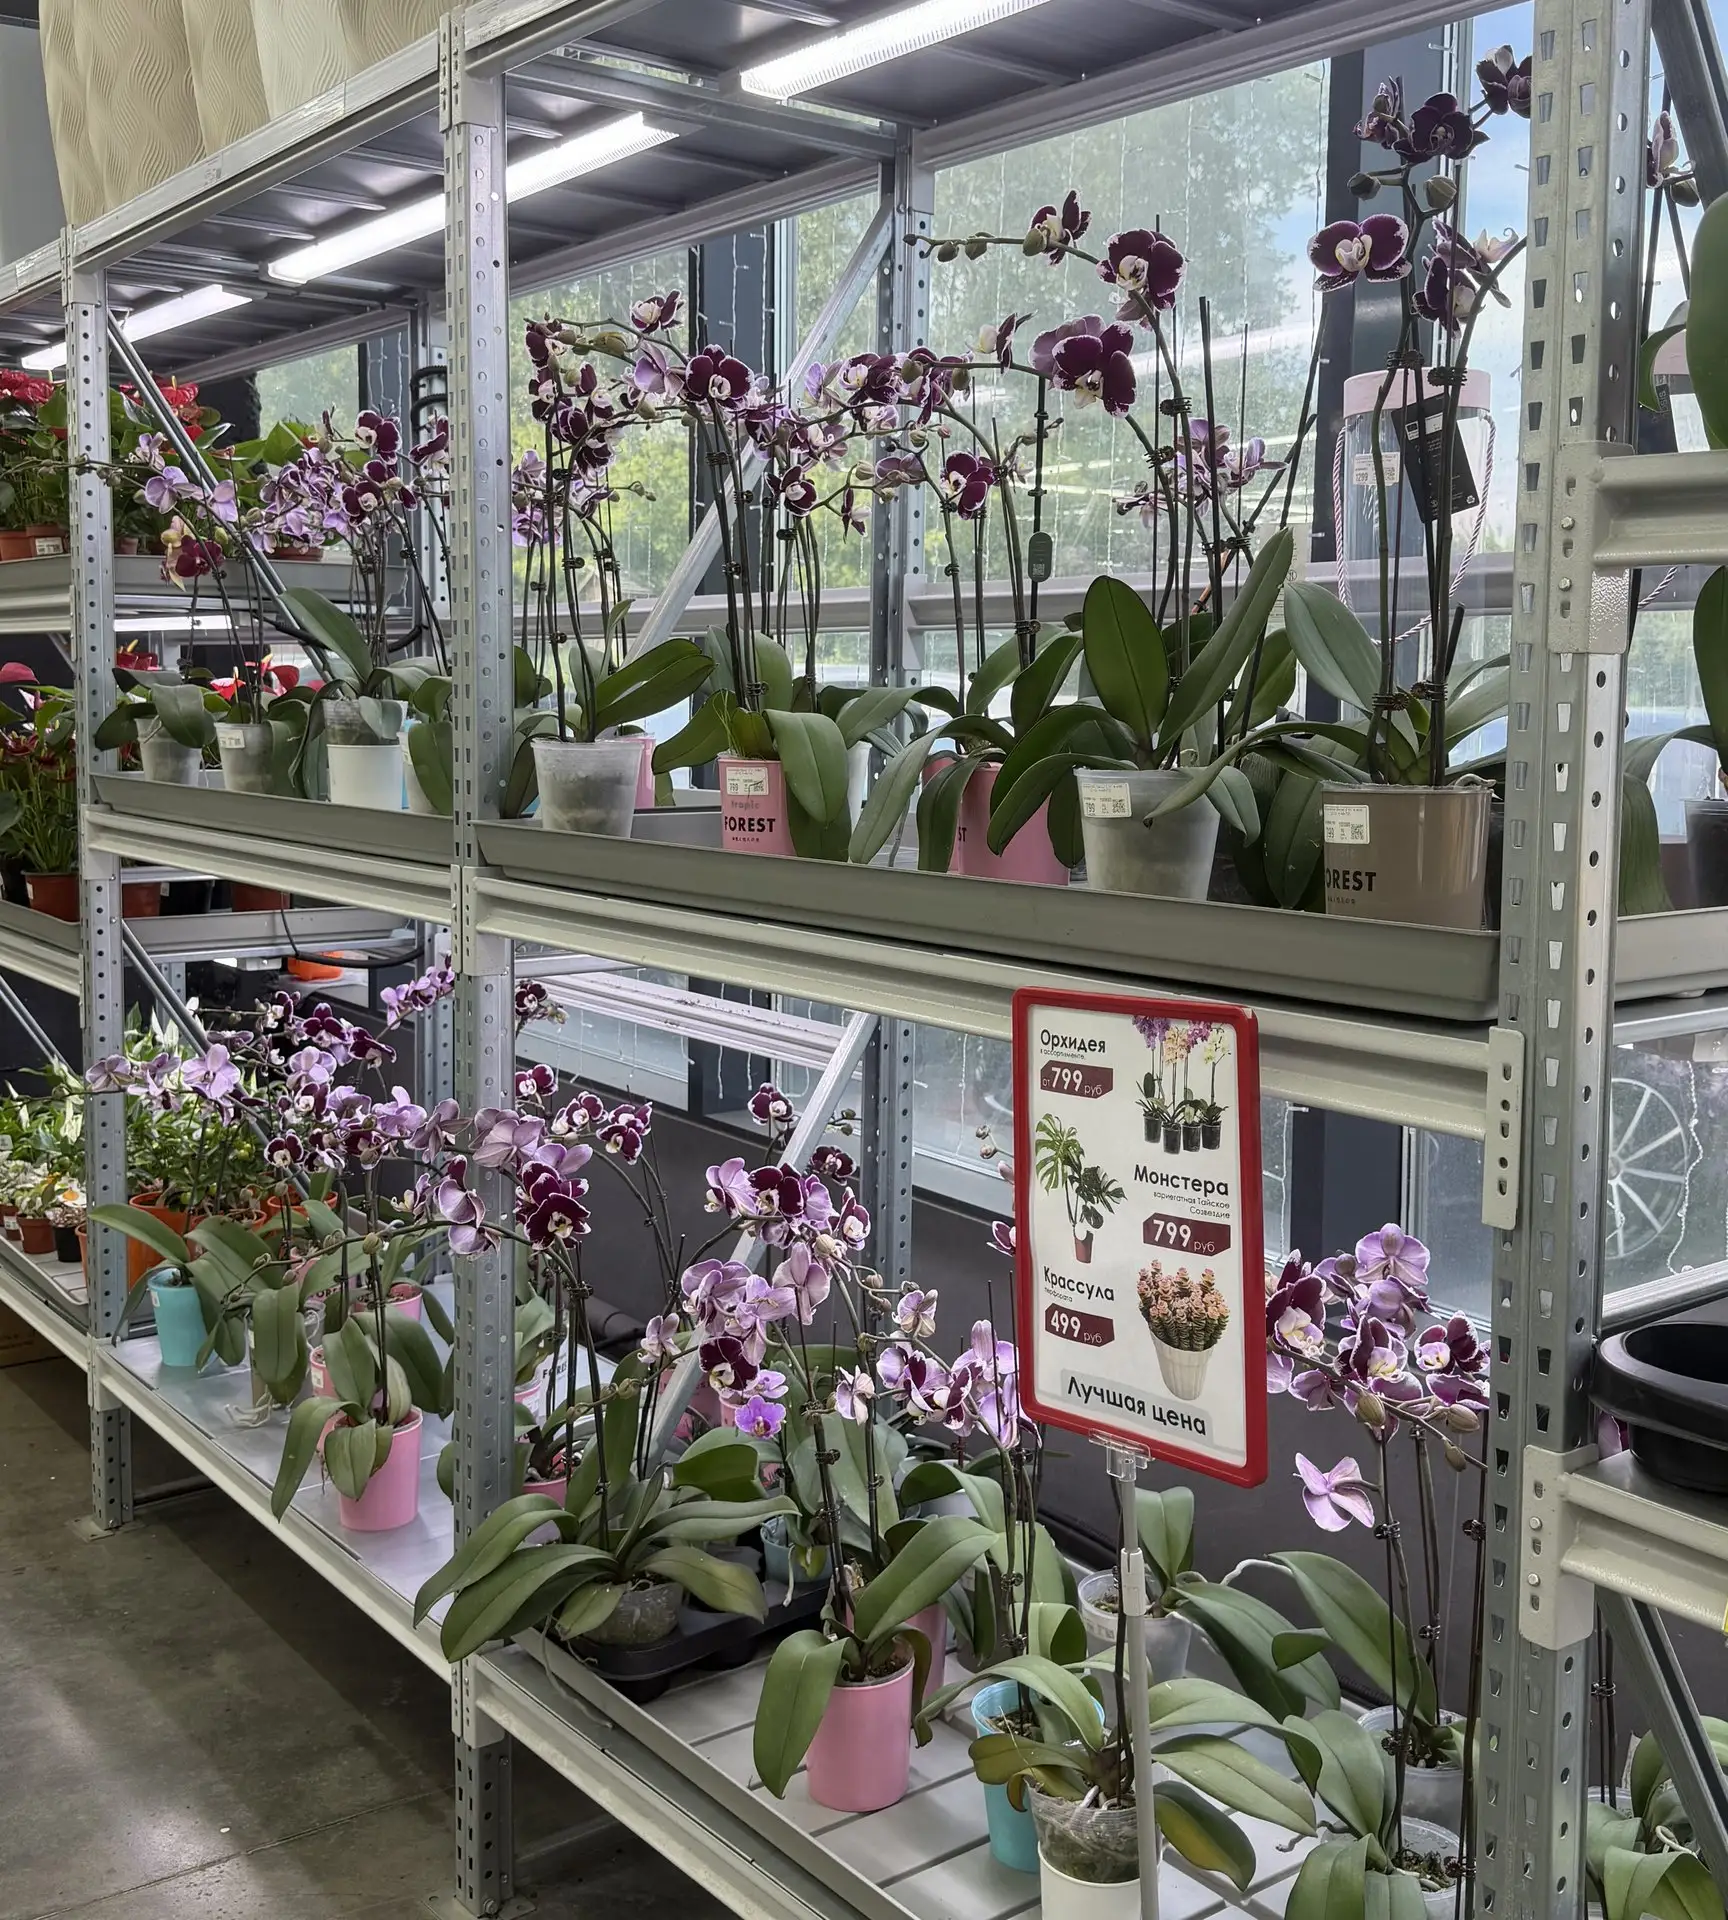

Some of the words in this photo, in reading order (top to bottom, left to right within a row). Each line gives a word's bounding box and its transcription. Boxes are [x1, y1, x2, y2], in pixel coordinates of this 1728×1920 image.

[1325, 868, 1376, 891] OREST
[1040, 1029, 1106, 1053] Орхидея
[1042, 1078, 1050, 1086] от
[1051, 1067, 1083, 1092] 799
[1084, 1085, 1103, 1096] руб
[1133, 1164, 1229, 1197] Монстера
[1153, 1220, 1191, 1247] 799
[1193, 1241, 1215, 1253] руб
[1043, 1265, 1115, 1302] Крассула
[1050, 1310, 1081, 1338] 499
[1083, 1332, 1102, 1343] руб
[1067, 1376, 1146, 1417] Лучшая
[1152, 1404, 1207, 1436] цена
